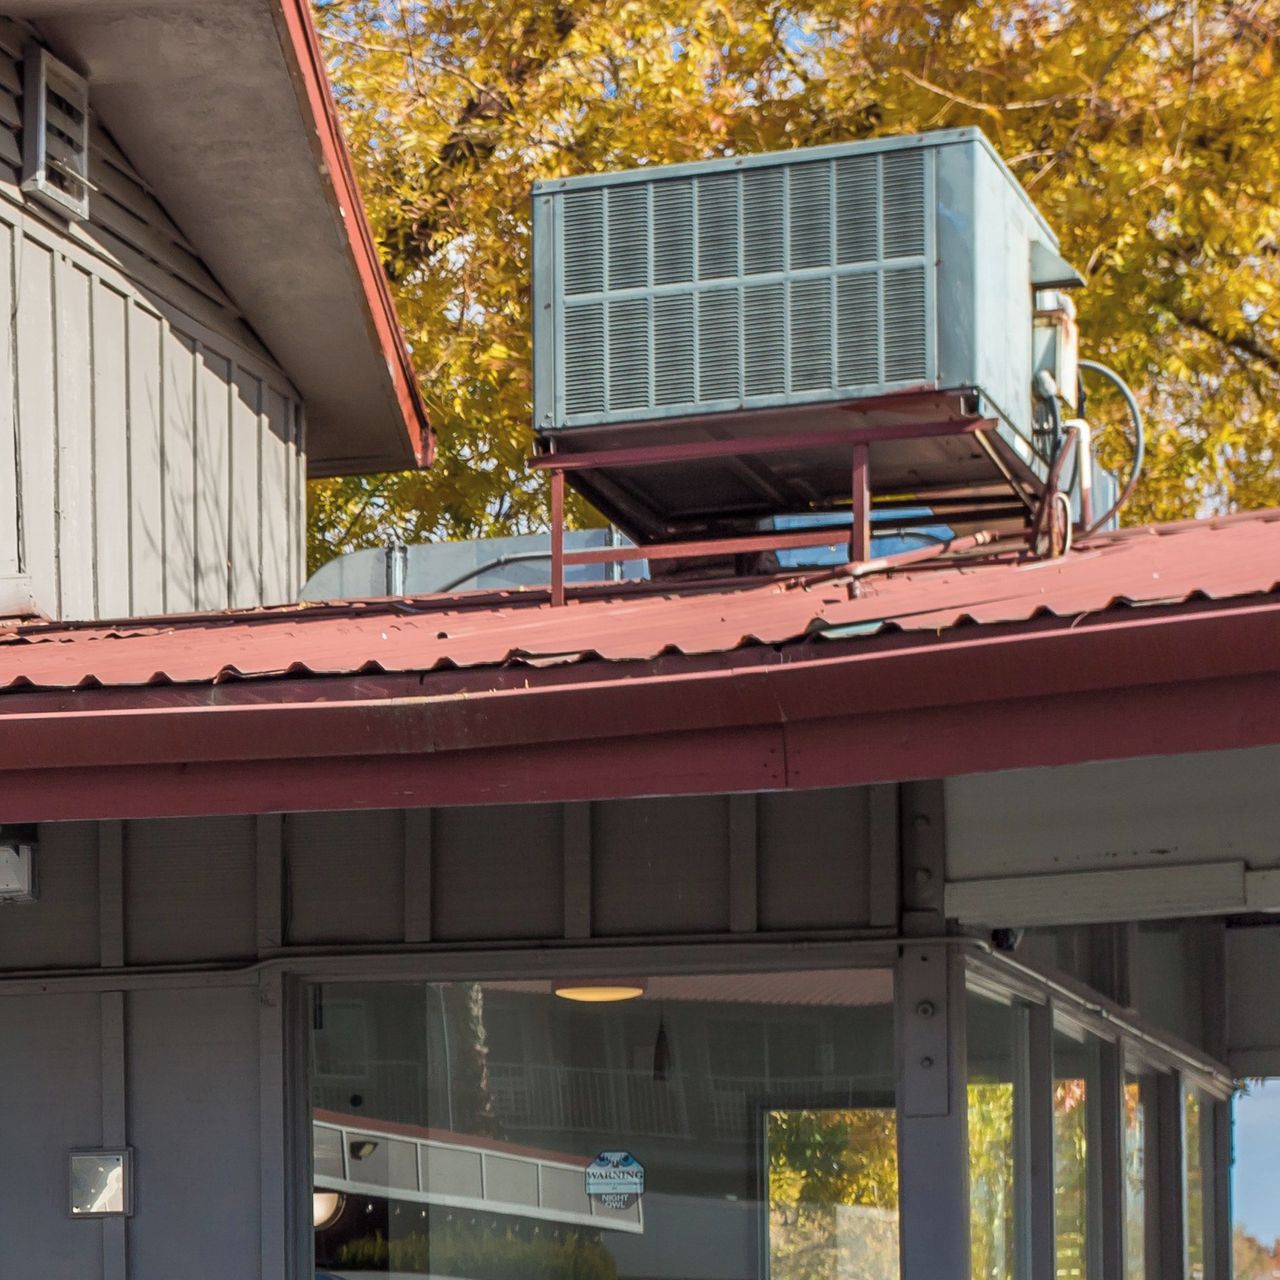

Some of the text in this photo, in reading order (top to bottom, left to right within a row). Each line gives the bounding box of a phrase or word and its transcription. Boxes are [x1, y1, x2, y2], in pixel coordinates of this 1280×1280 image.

[587, 1171, 643, 1180] WARNING
[601, 1194, 629, 1202] NIGHT
[604, 1201, 626, 1209] OWL
